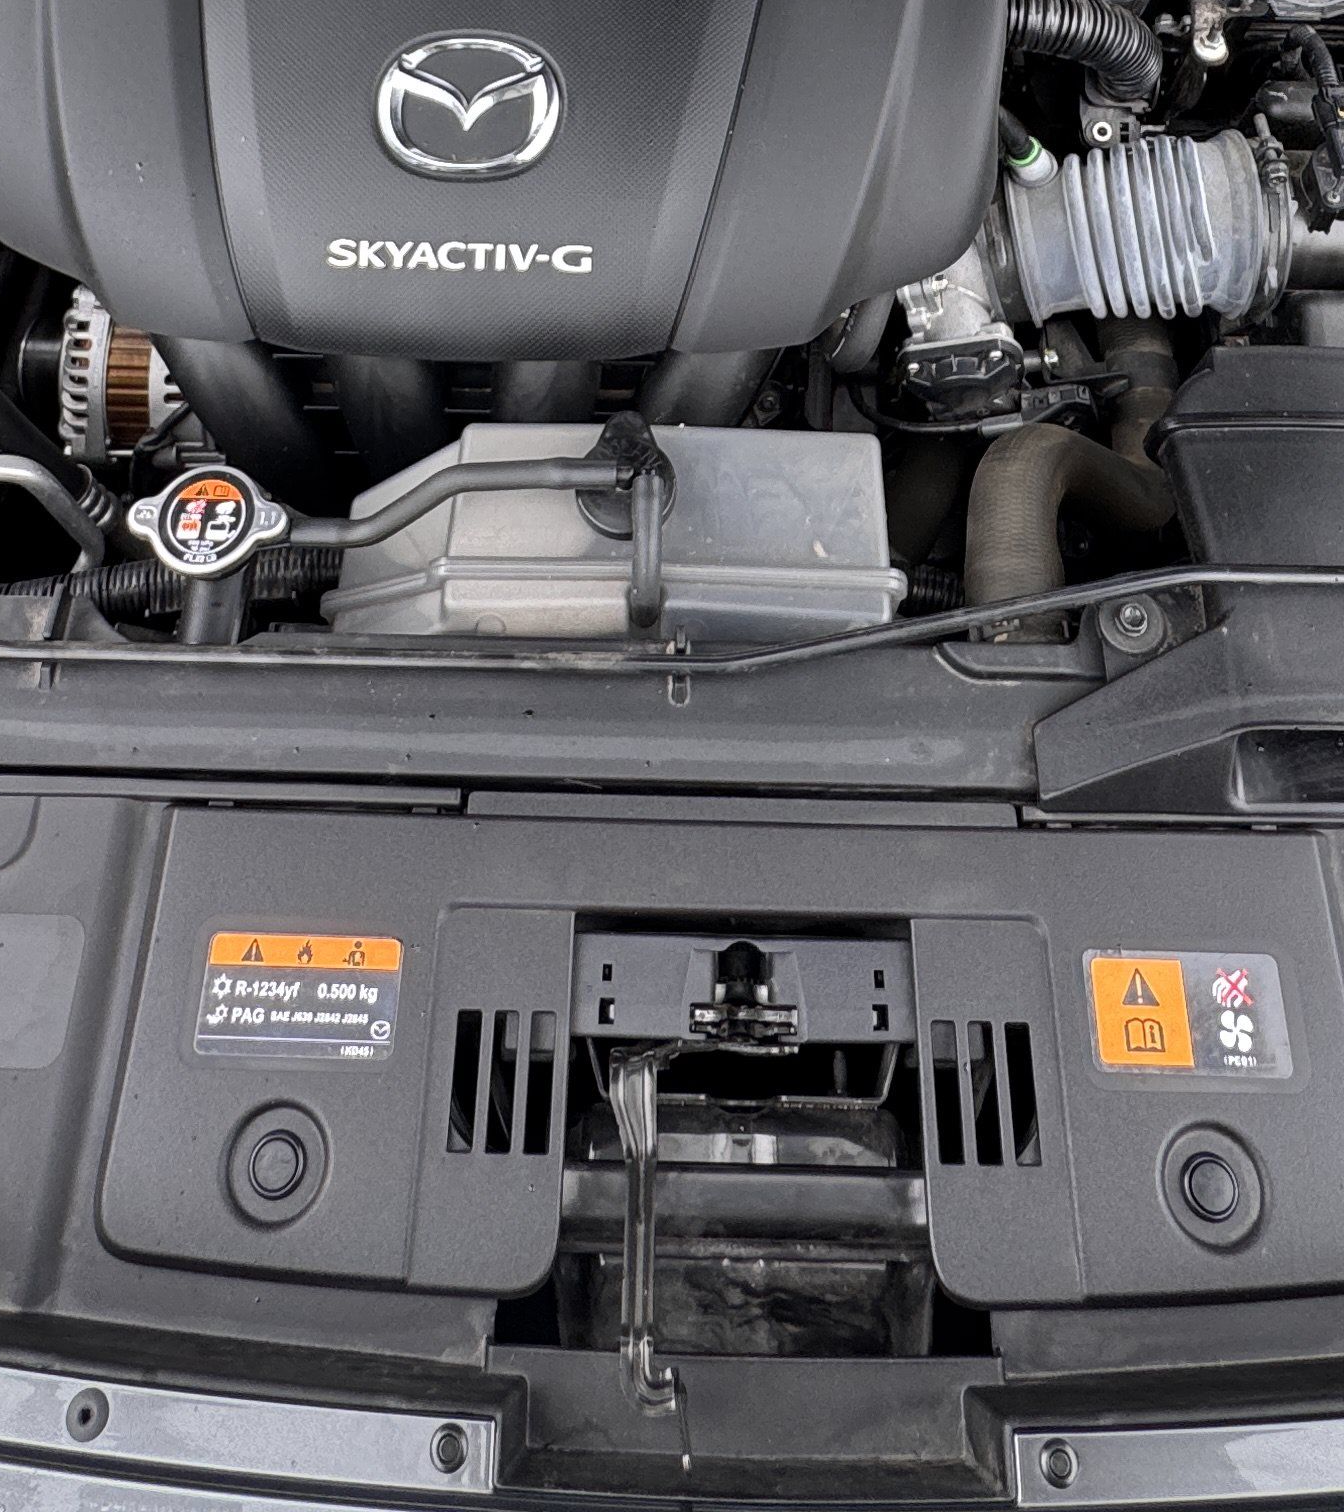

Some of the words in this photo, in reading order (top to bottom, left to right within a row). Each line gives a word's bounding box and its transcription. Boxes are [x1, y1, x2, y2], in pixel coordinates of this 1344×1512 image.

[327, 238, 594, 274] SKYACTIV-G
[259, 511, 276, 526] 1.1
[234, 980, 301, 1002] R-1234yf
[317, 983, 357, 1000] 0.500
[358, 984, 379, 1004] kg
[231, 1007, 265, 1025] PAG
